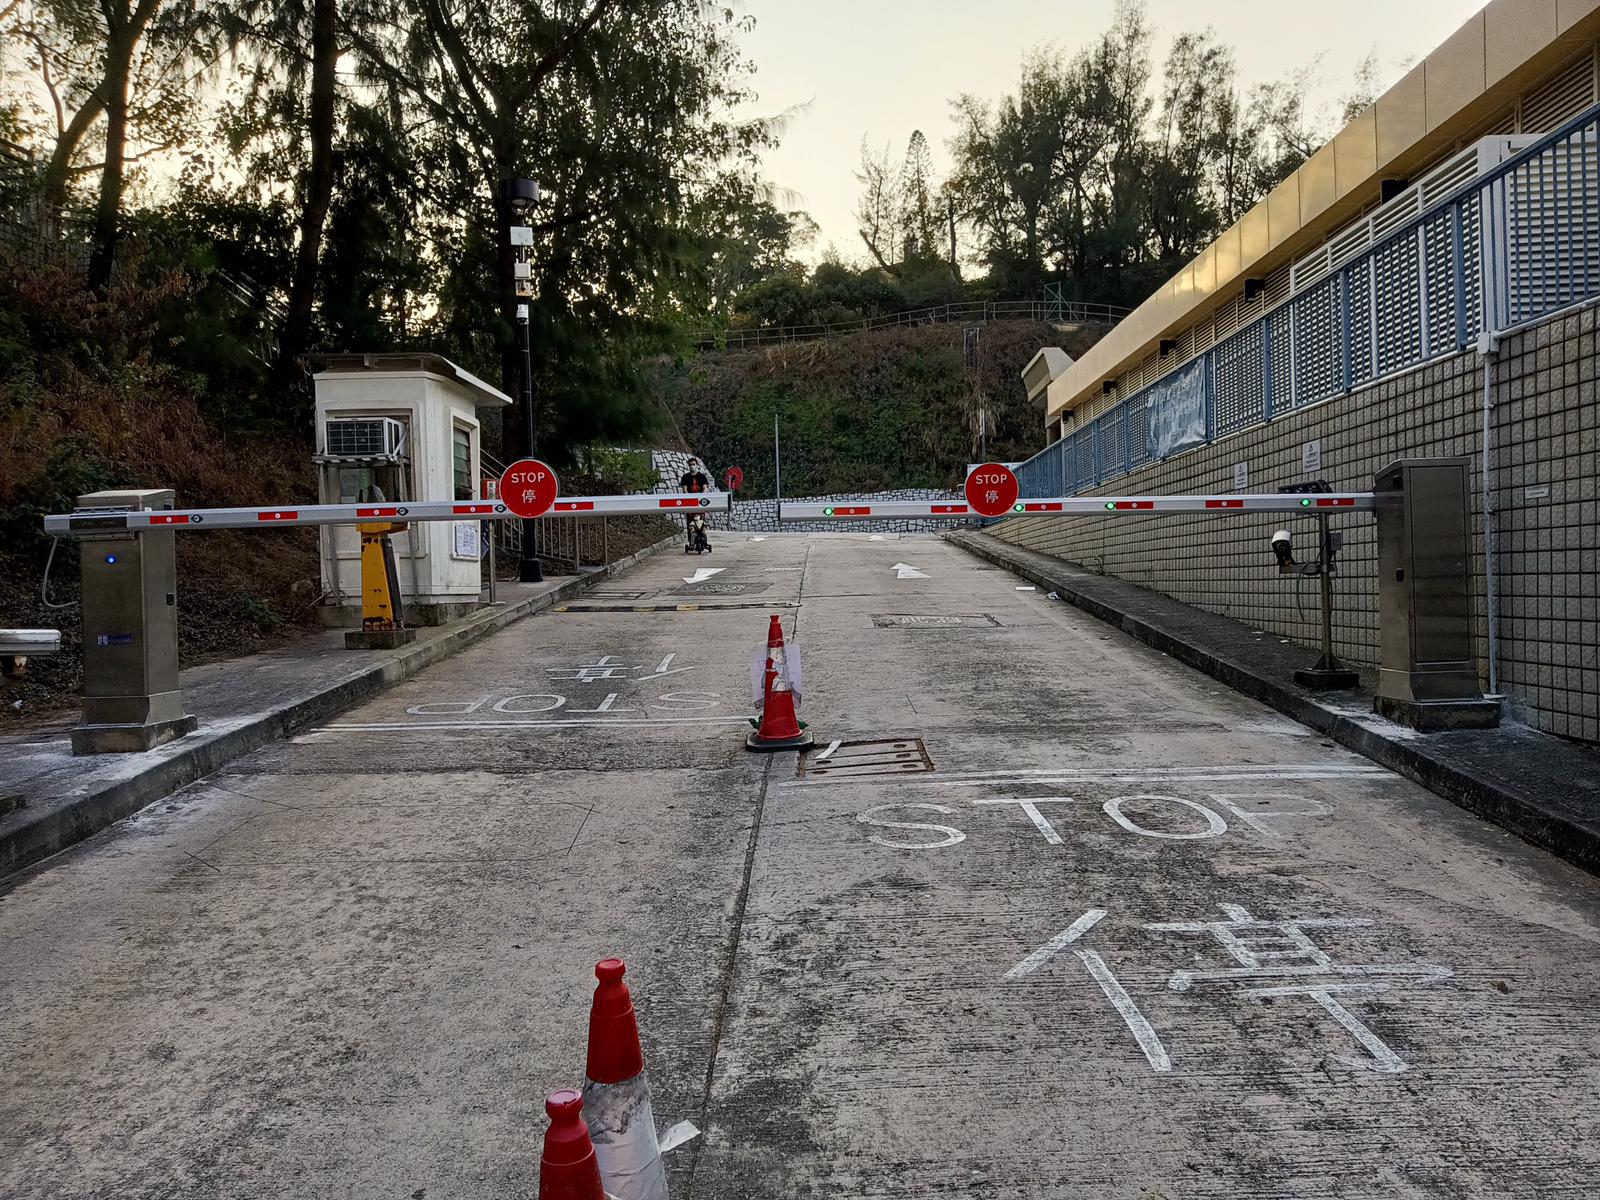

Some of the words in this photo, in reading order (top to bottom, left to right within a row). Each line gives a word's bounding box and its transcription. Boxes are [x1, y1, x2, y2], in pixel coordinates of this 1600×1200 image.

[511, 472, 545, 483] STOP
[975, 474, 1008, 485] STOP
[521, 489, 536, 503] 停
[985, 490, 999, 503] 停
[406, 692, 712, 714] STOP
[856, 794, 1336, 849] STOP
[1002, 902, 1454, 1073] 停
